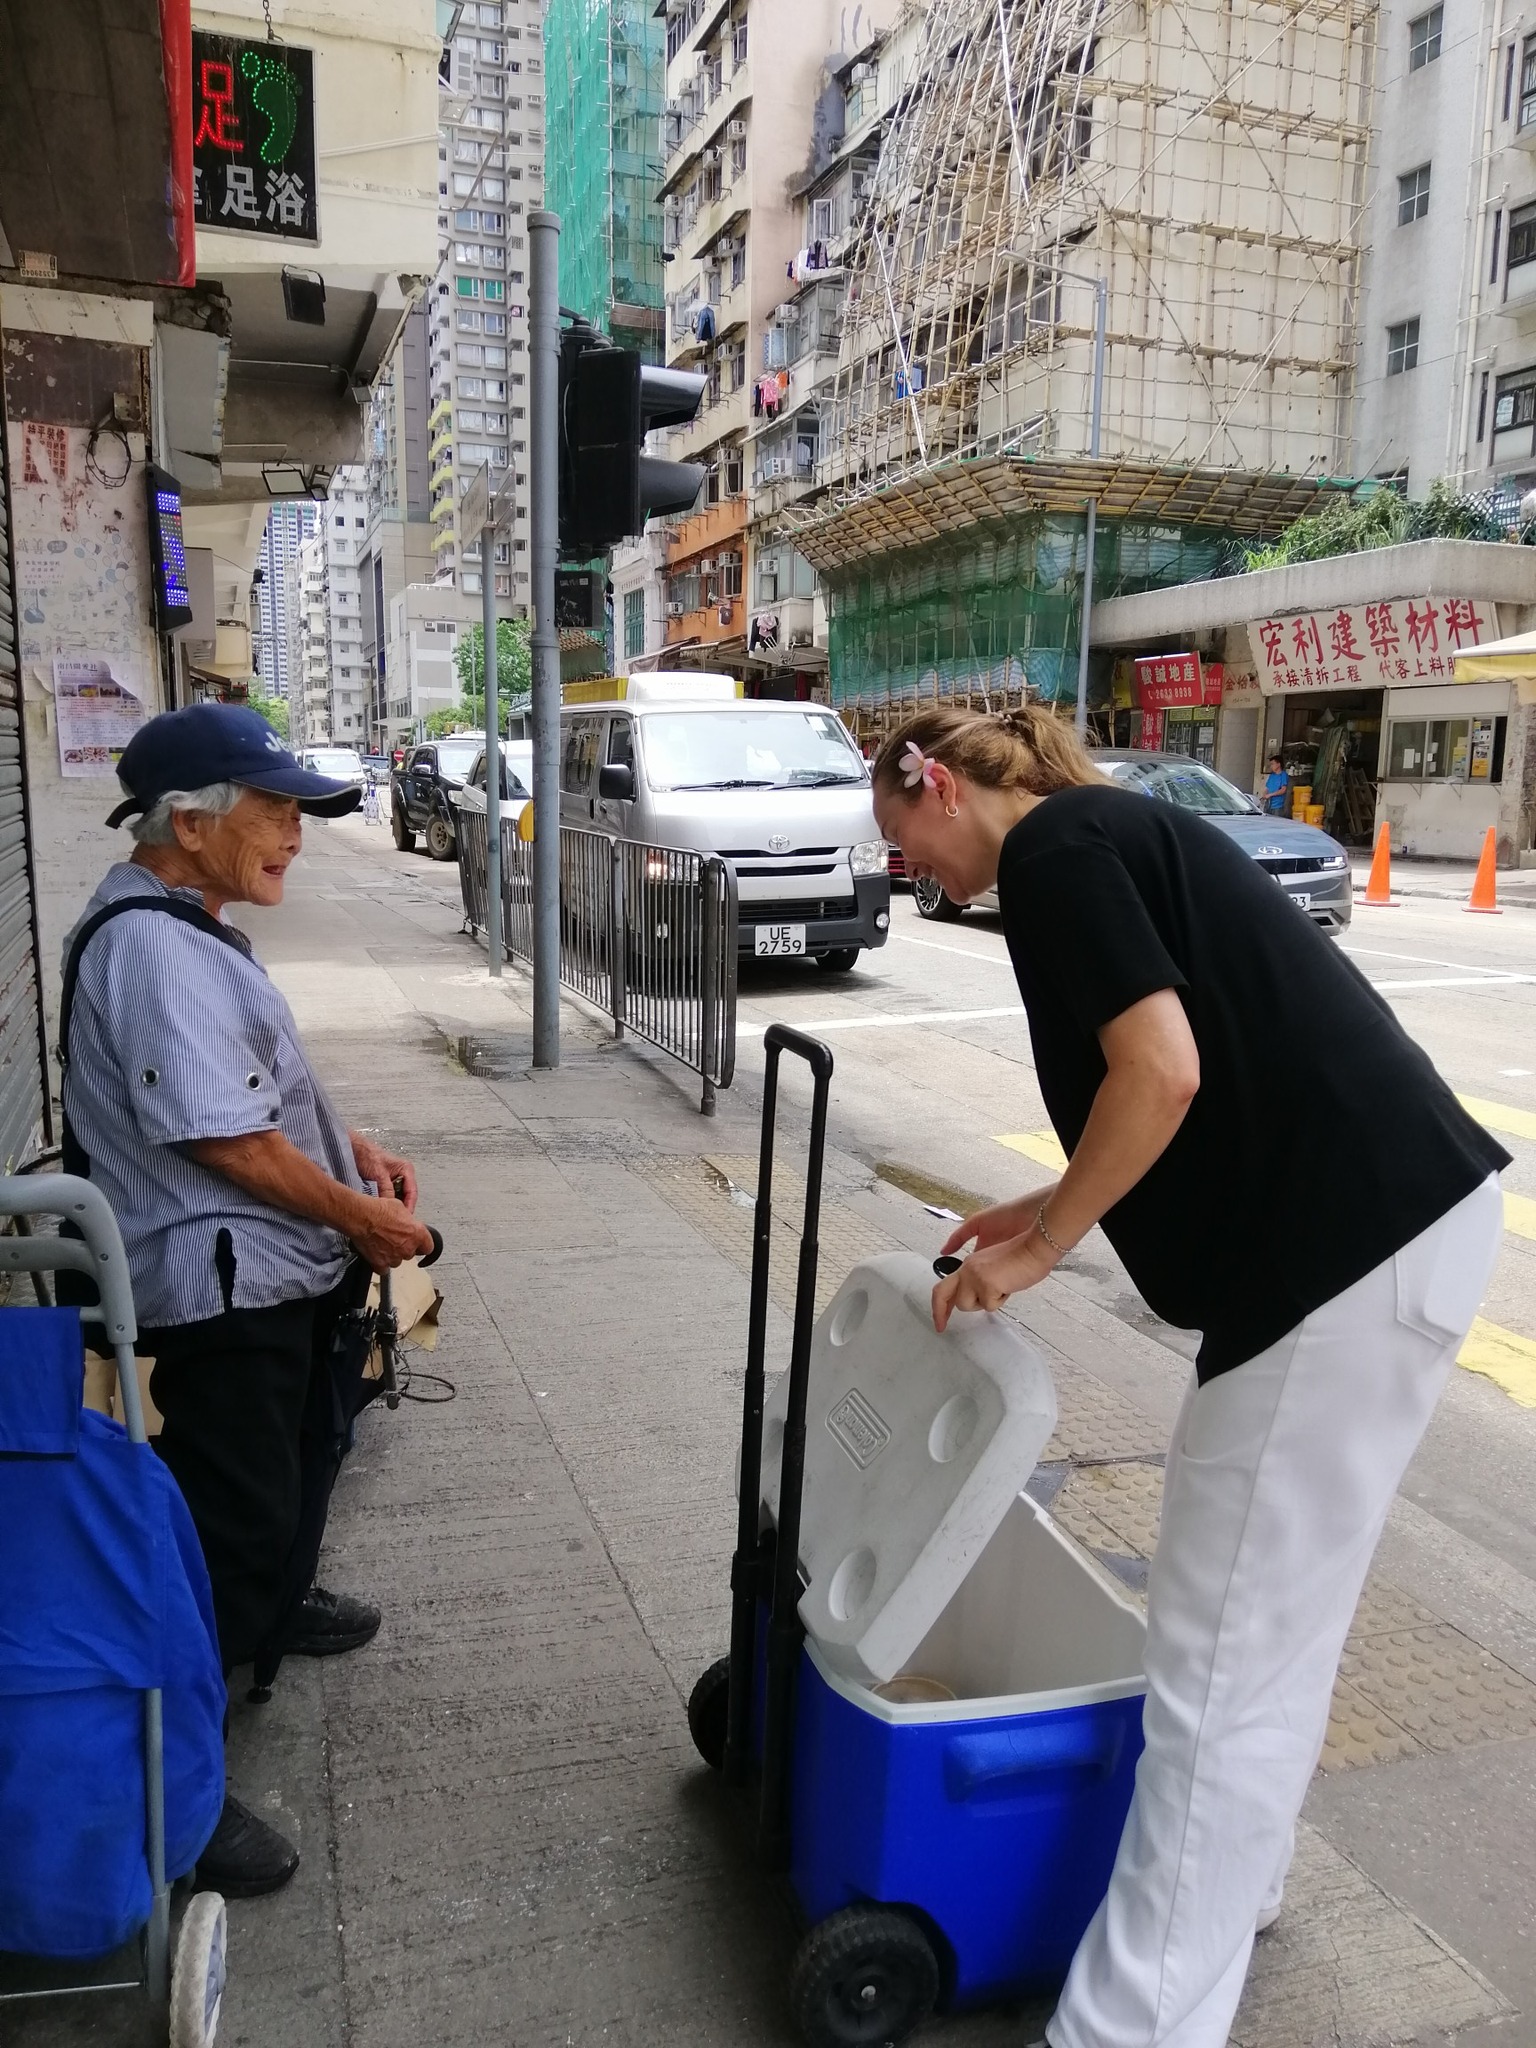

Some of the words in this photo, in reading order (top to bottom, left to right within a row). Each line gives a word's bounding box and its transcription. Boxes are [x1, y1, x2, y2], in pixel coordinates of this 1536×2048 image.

[195, 59, 244, 152] 足
[193, 163, 306, 227] 足浴
[1259, 598, 1484, 668] 宏利建築材料
[1272, 666, 1362, 688] 承接清拆工程
[759, 940, 802, 955] 2759
[770, 927, 791, 940] UE
